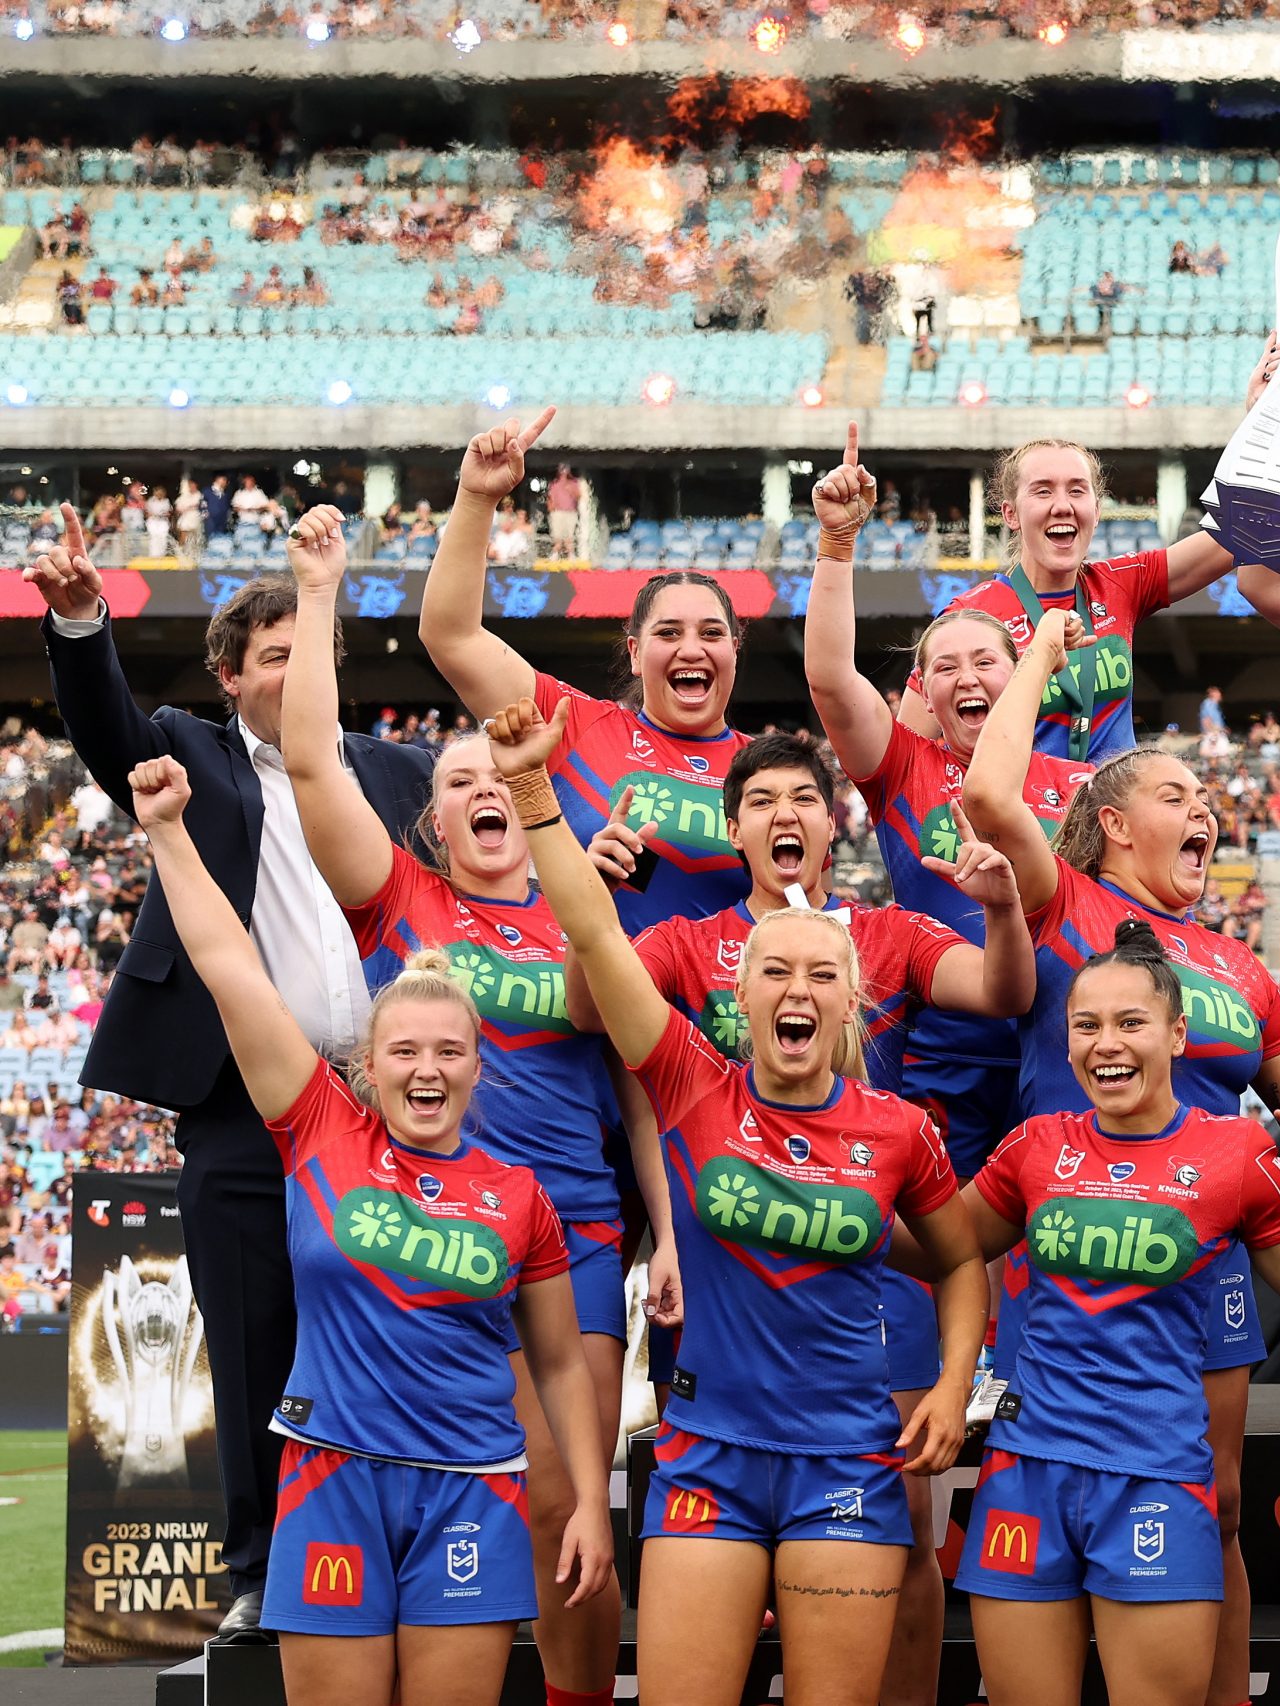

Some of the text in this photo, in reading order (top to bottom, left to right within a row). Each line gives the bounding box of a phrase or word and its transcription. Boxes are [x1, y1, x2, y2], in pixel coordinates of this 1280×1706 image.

[1181, 984, 1256, 1038] nib
[841, 1168, 877, 1178] KNIGHTS
[1158, 1184, 1199, 1200] KNIGHTS
[122, 1214, 146, 1225] NSW
[474, 1206, 508, 1220] KNIGHTS
[761, 1198, 868, 1254] nib
[1080, 1216, 1178, 1274] nib
[400, 1224, 498, 1285] nib
[1220, 1276, 1241, 1285] CLASSIC
[825, 1489, 856, 1500] CLASSIC
[1130, 1503, 1160, 1514] CLASSIC
[106, 1522, 209, 1540] 2023 NRLW
[443, 1523, 474, 1533] CLASSIC
[826, 1530, 864, 1538] PREMIERSHIP
[82, 1542, 230, 1576] GRAND
[94, 1578, 218, 1613] FINAL
